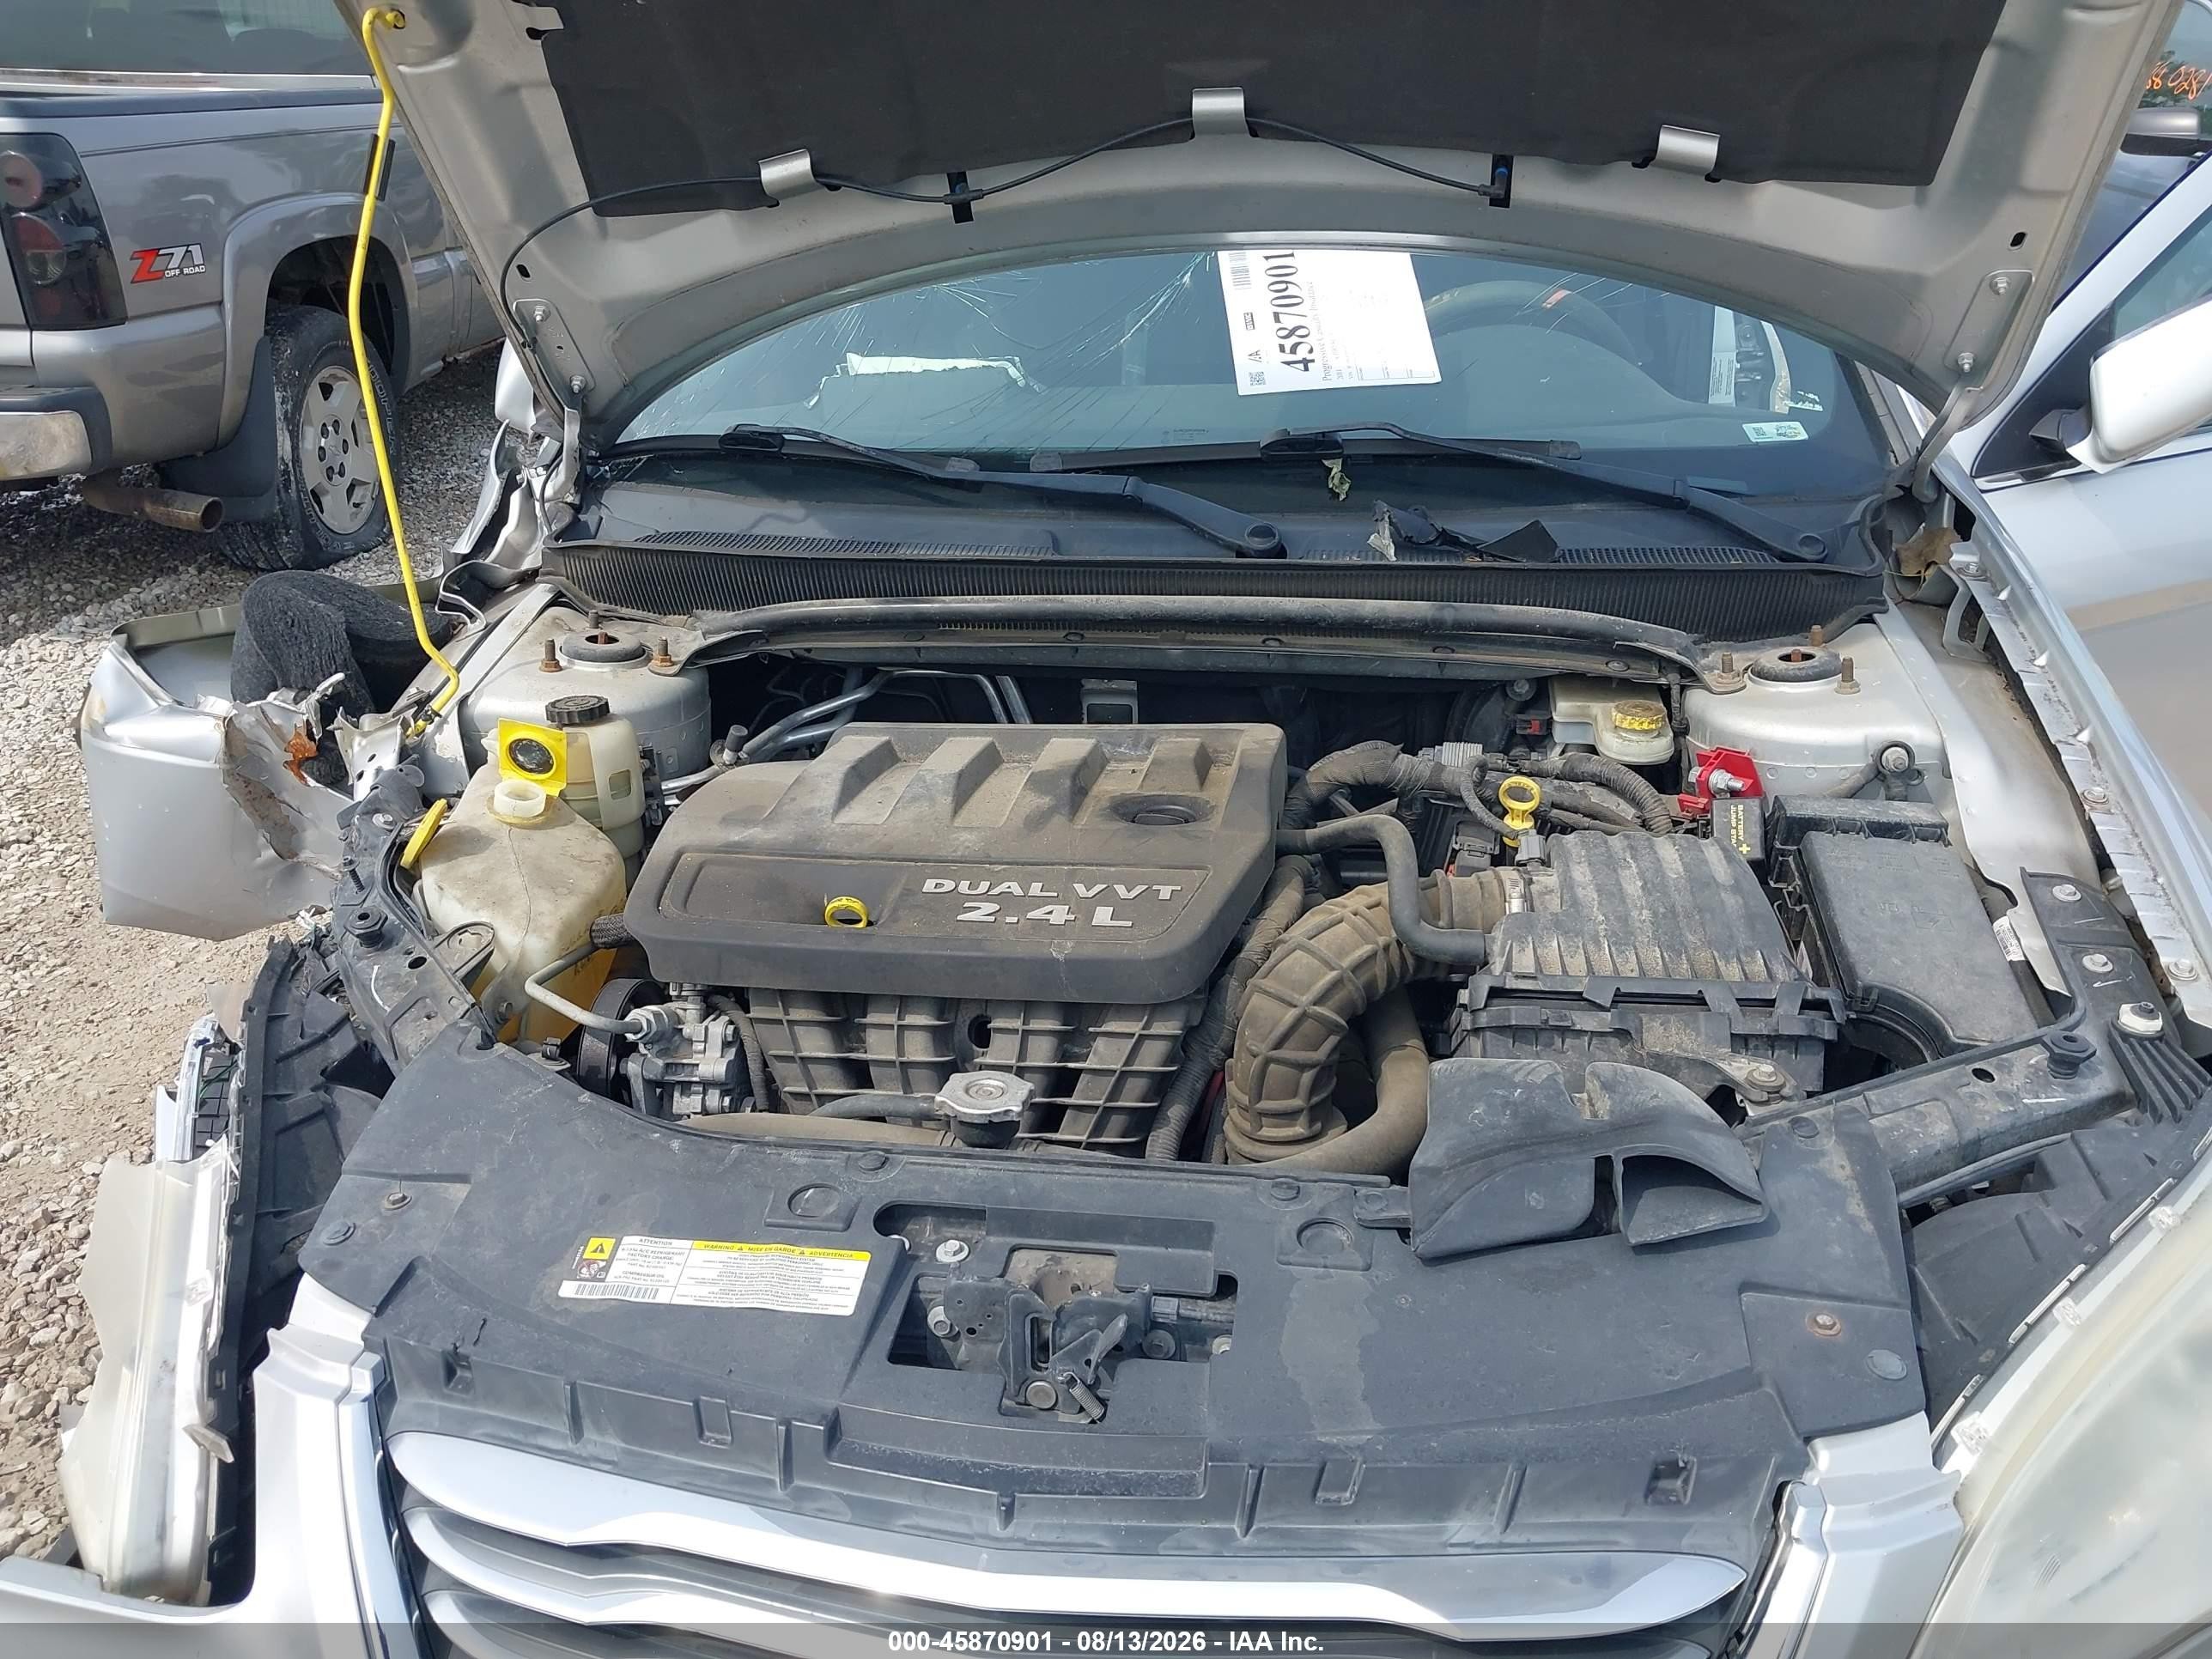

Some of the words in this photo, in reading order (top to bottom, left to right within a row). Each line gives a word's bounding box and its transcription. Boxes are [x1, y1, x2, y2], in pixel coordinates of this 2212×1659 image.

[130, 243, 204, 283] Z71
[164, 270, 180, 278] OFF
[183, 264, 206, 276] ROAD
[1262, 252, 1316, 372] 45870901
[921, 878, 1058, 897] DUAL
[1073, 883, 1182, 900] VVT
